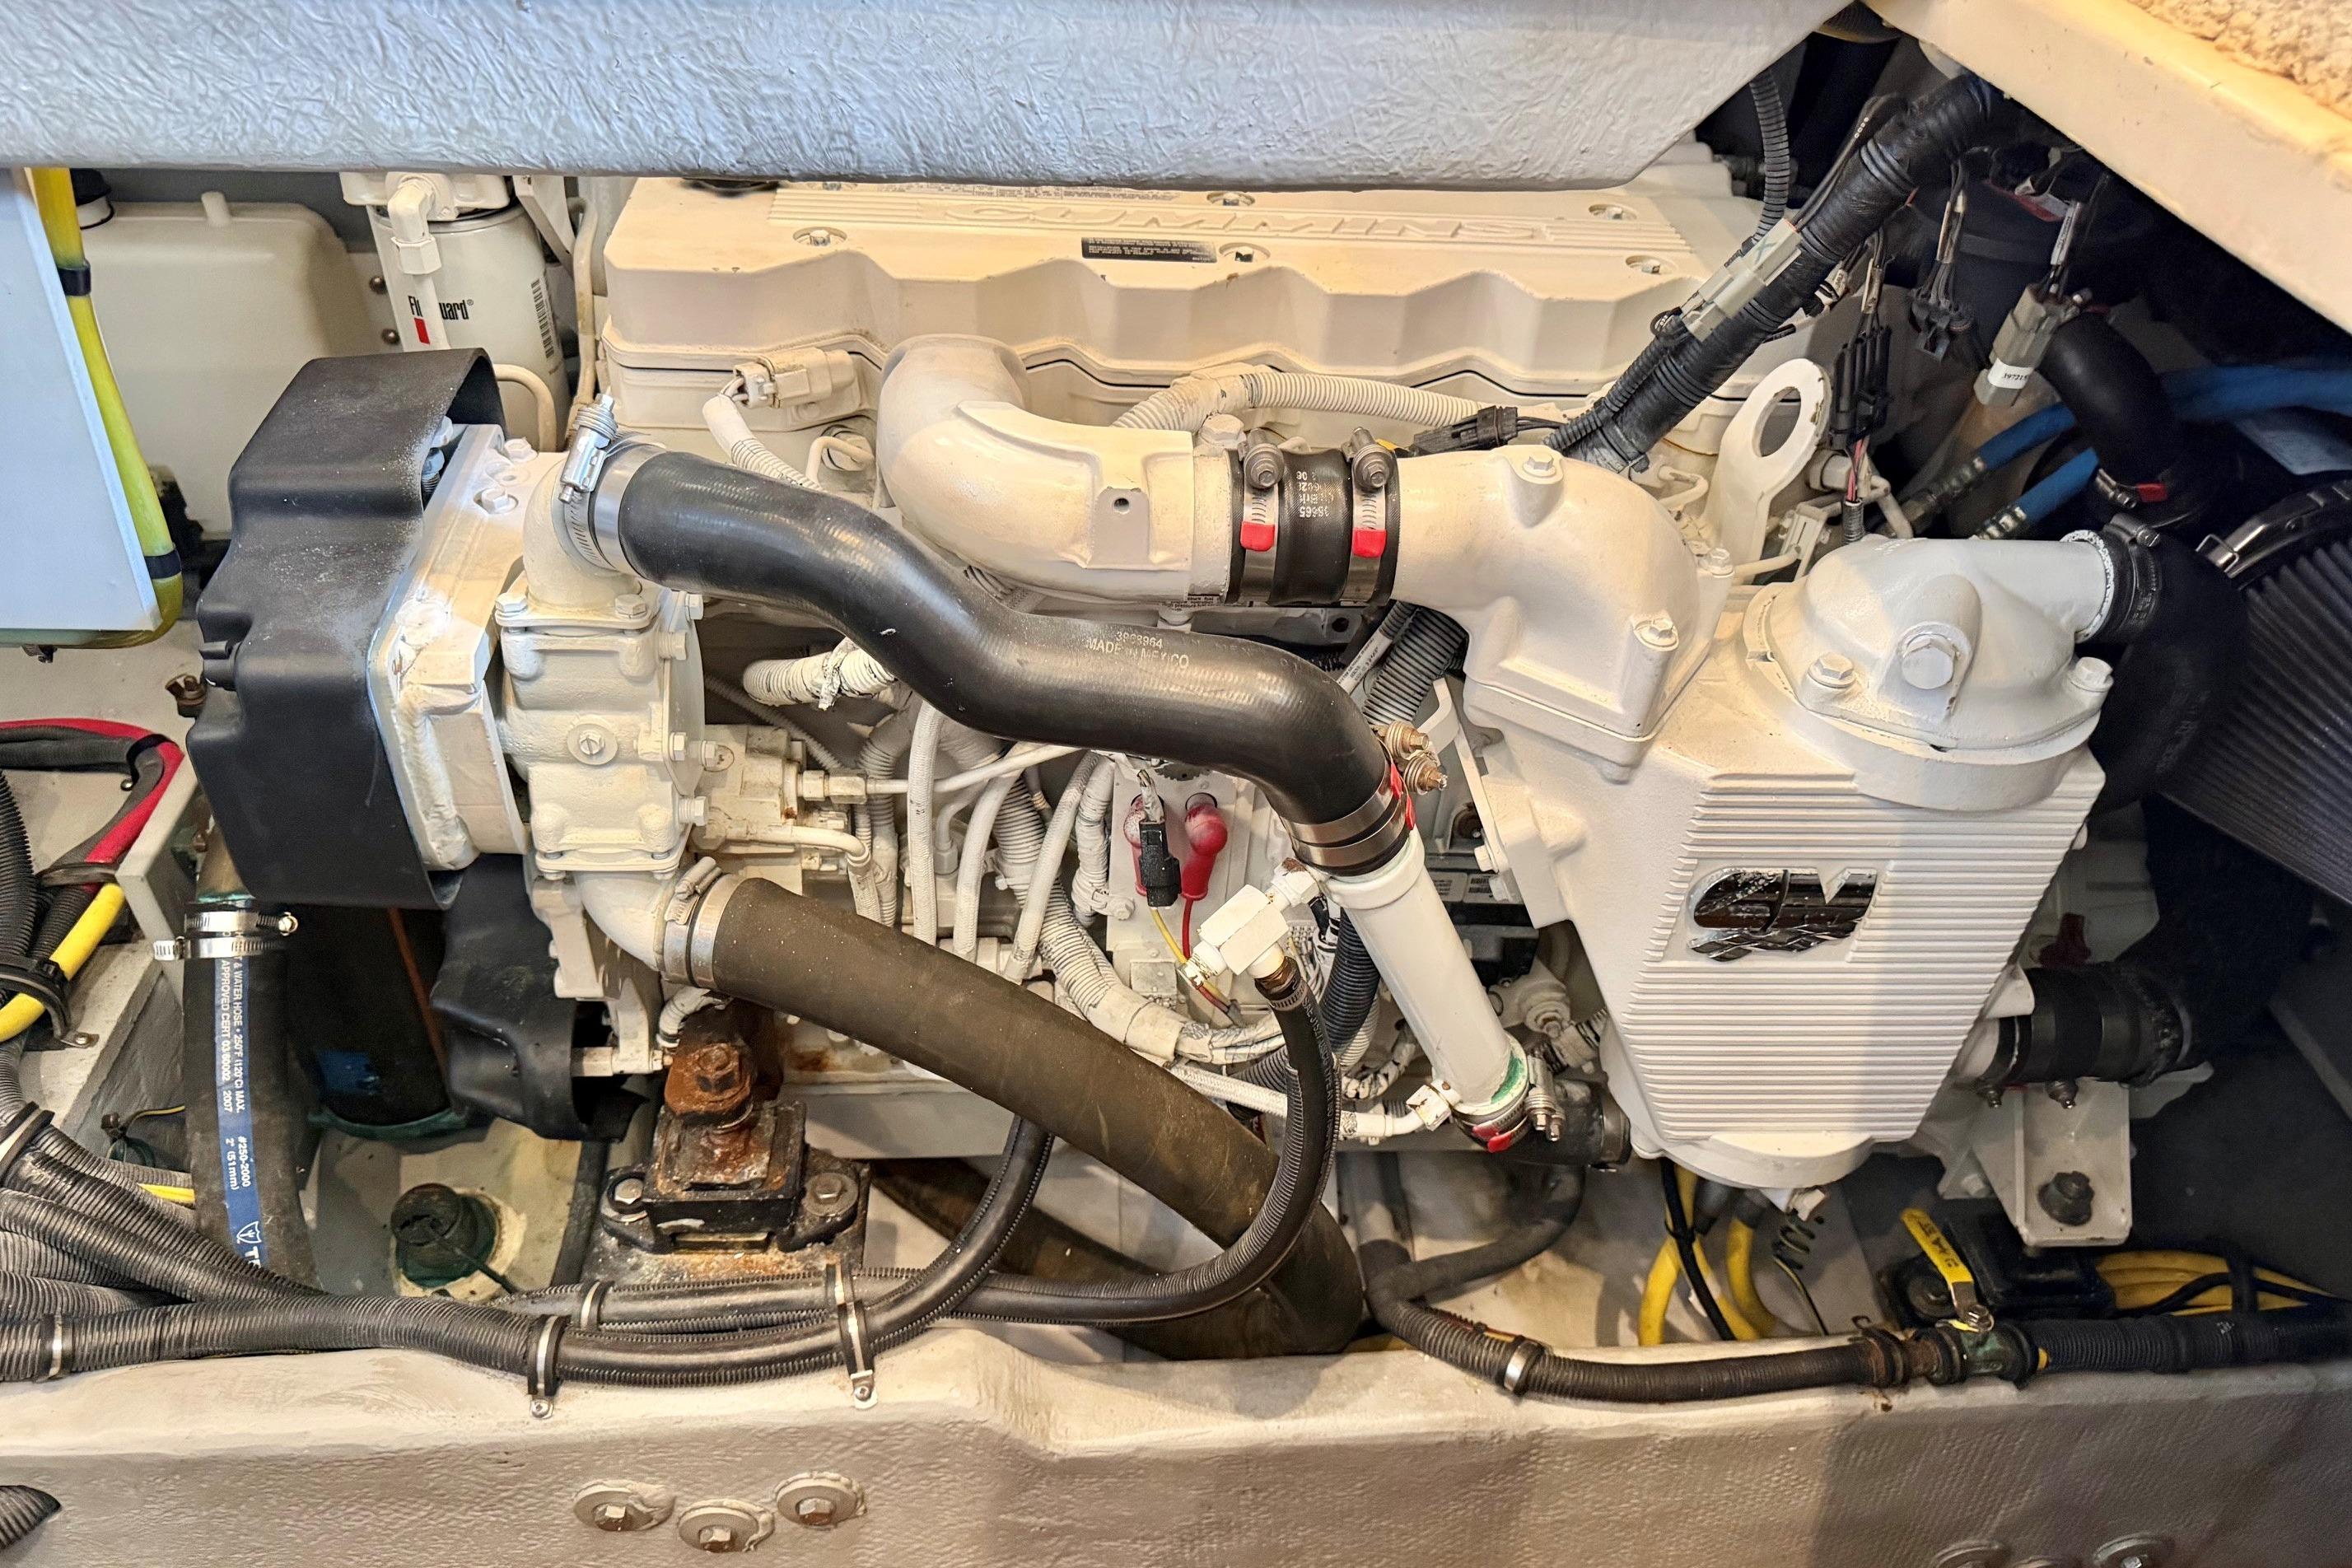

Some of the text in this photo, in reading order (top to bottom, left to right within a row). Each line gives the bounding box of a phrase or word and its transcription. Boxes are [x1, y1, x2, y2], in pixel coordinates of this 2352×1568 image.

[1085, 637, 1122, 656] MADE
[1140, 646, 1190, 669] MEXICO
[221, 959, 231, 1011] APPROVED
[234, 970, 244, 1001] WATER
[221, 1013, 231, 1038] CERT
[234, 1002, 244, 1027] HOSE
[222, 1090, 232, 1113] 2007
[226, 1150, 240, 1191] (51mm)
[238, 1136, 252, 1188] #250-2000
